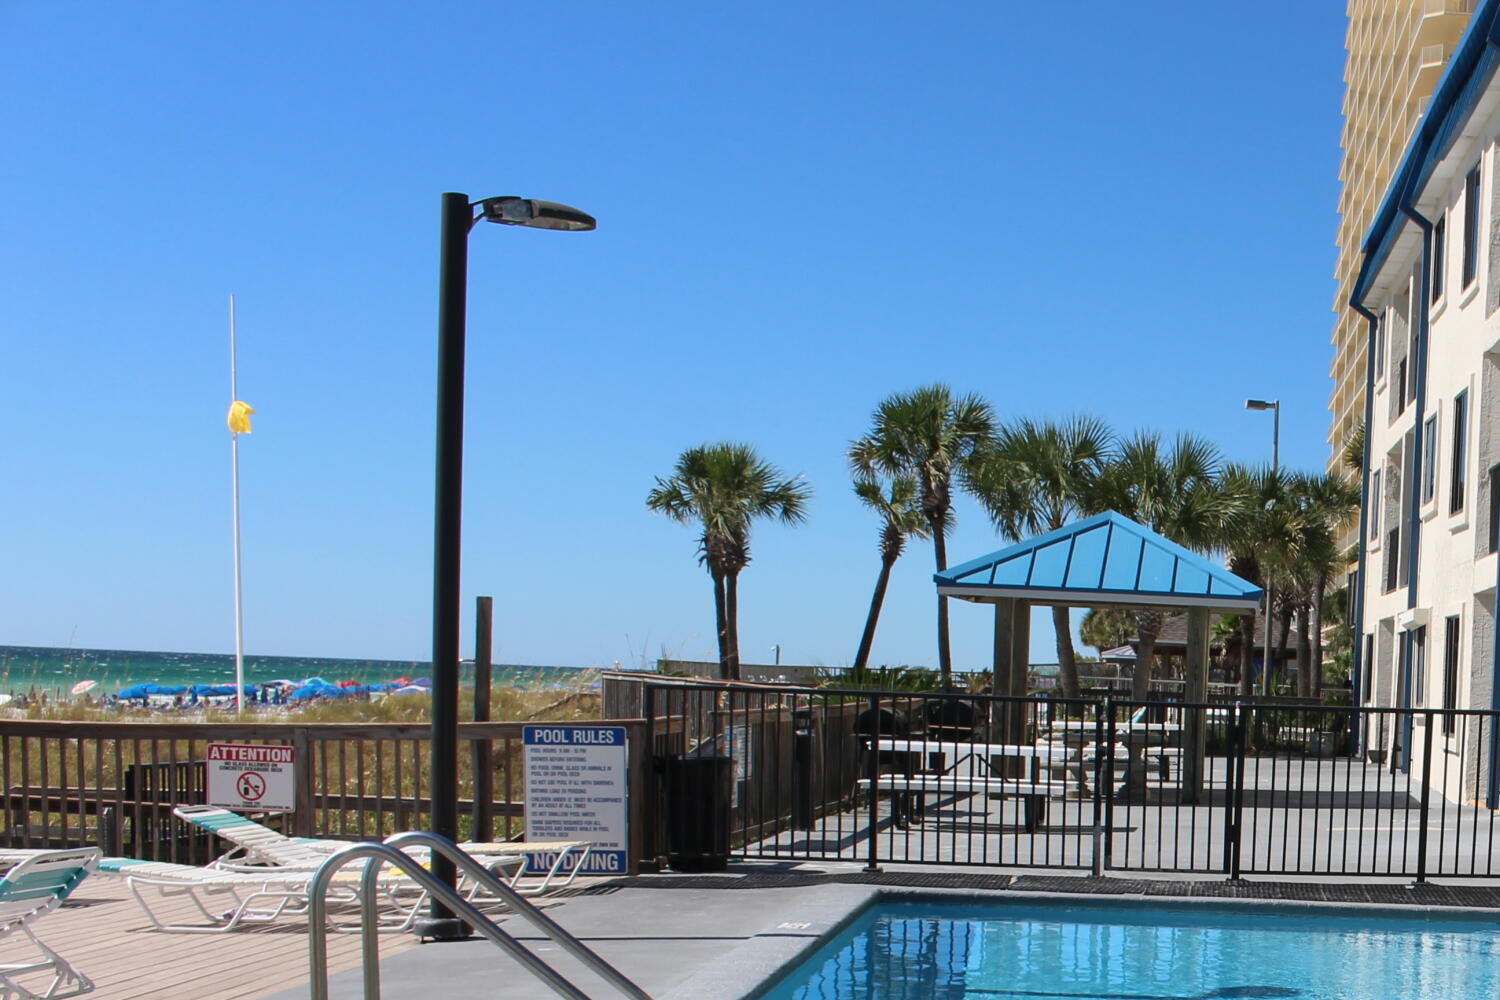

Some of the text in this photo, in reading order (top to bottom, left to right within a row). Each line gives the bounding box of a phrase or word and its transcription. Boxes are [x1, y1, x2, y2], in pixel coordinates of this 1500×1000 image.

[535, 730, 614, 744] POOL RULES
[210, 747, 291, 762] ATTENTION
[534, 853, 618, 870] NO DIVING
